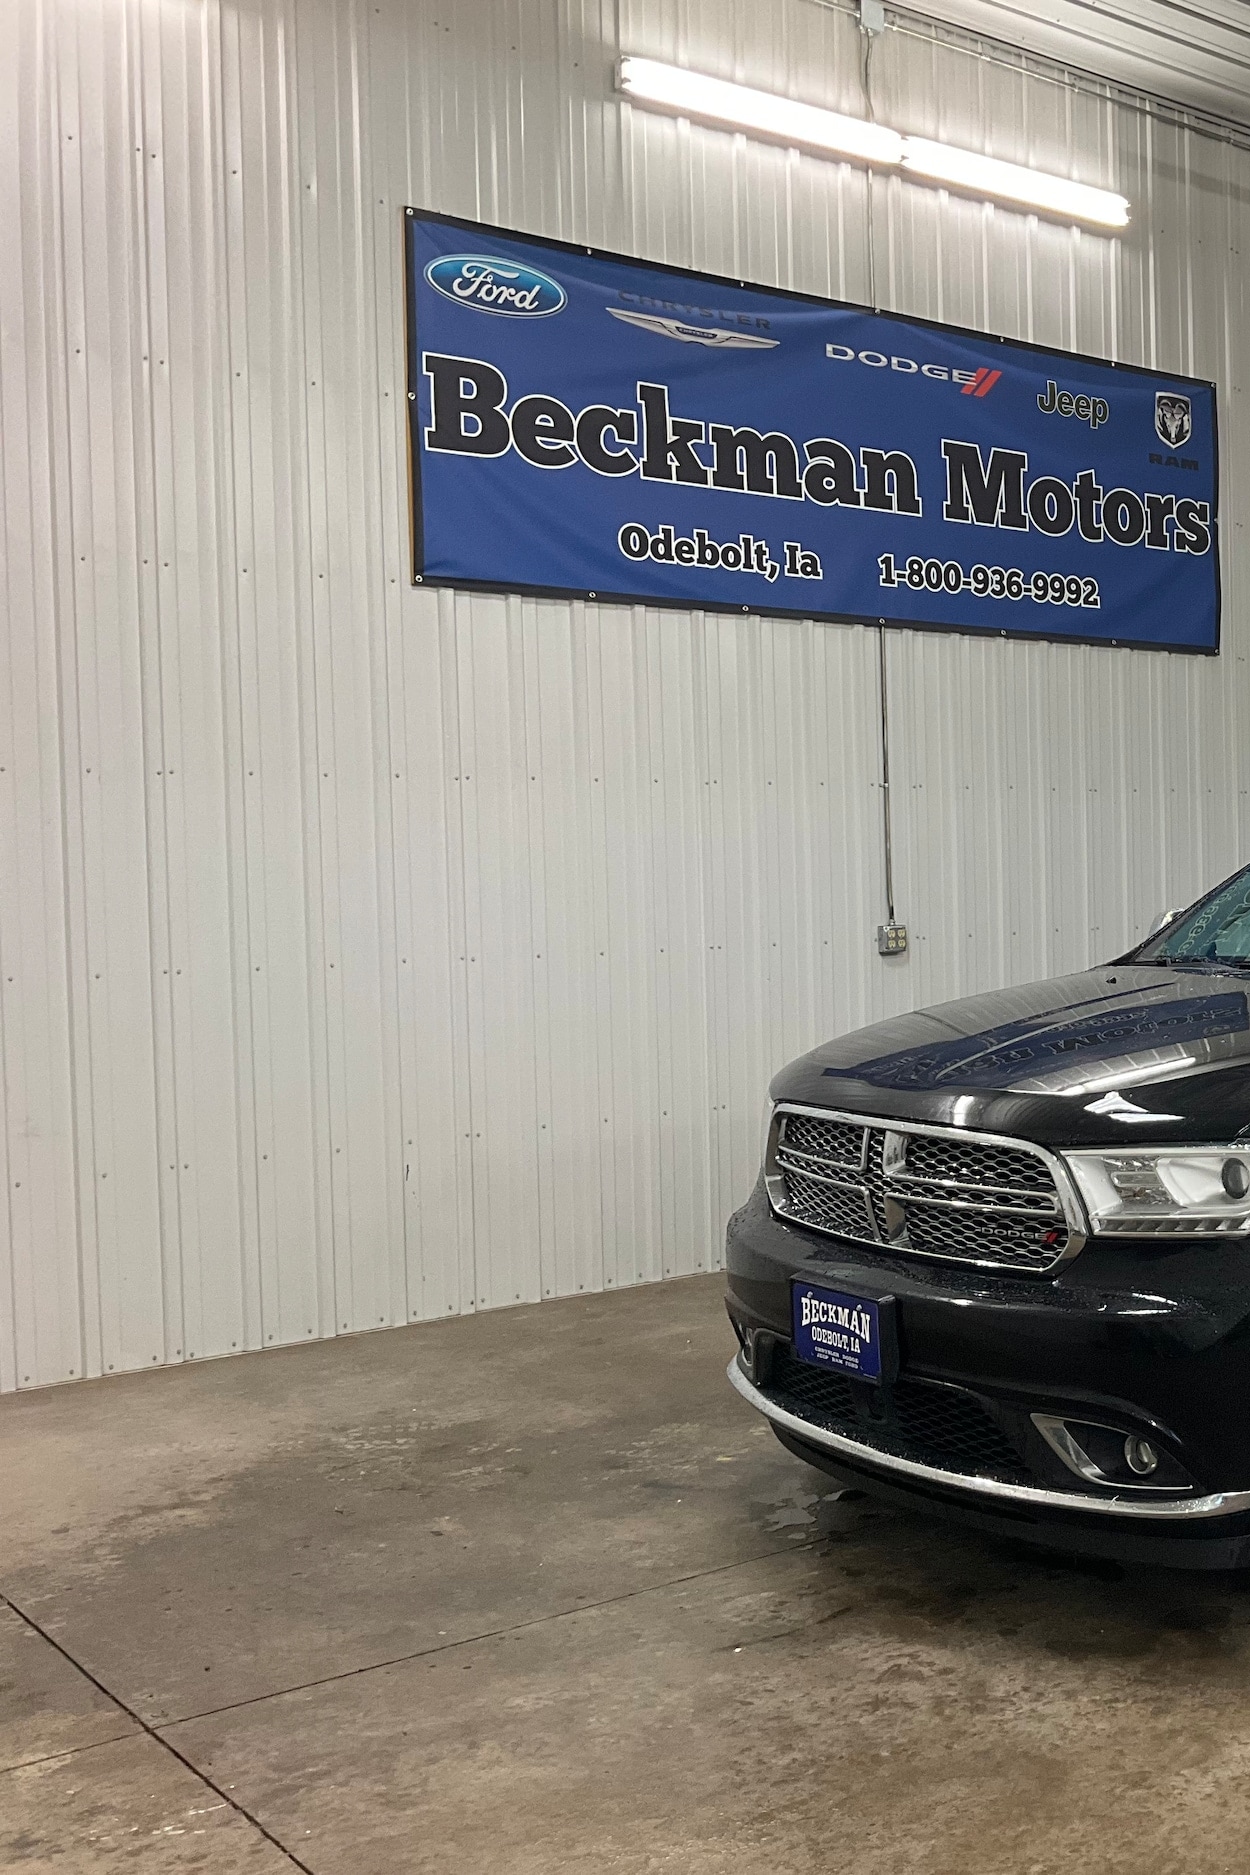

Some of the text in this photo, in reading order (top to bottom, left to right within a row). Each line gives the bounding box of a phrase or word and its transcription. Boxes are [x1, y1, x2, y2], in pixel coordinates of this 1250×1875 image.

[452, 262, 541, 310] Ford
[617, 290, 771, 329] CHRYSLER
[825, 343, 977, 386] DODGE
[1036, 380, 1110, 430] Jeep
[422, 351, 1211, 556] Beckman Motors
[1148, 453, 1199, 471] RAM
[617, 523, 823, 582] Odebolt, Ia
[877, 553, 1101, 609] 1-800-936-9992
[981, 1226, 1048, 1241] DODGE
[801, 1297, 871, 1344] BECKMAN
[811, 1325, 861, 1354] ODEBOLT, IA
